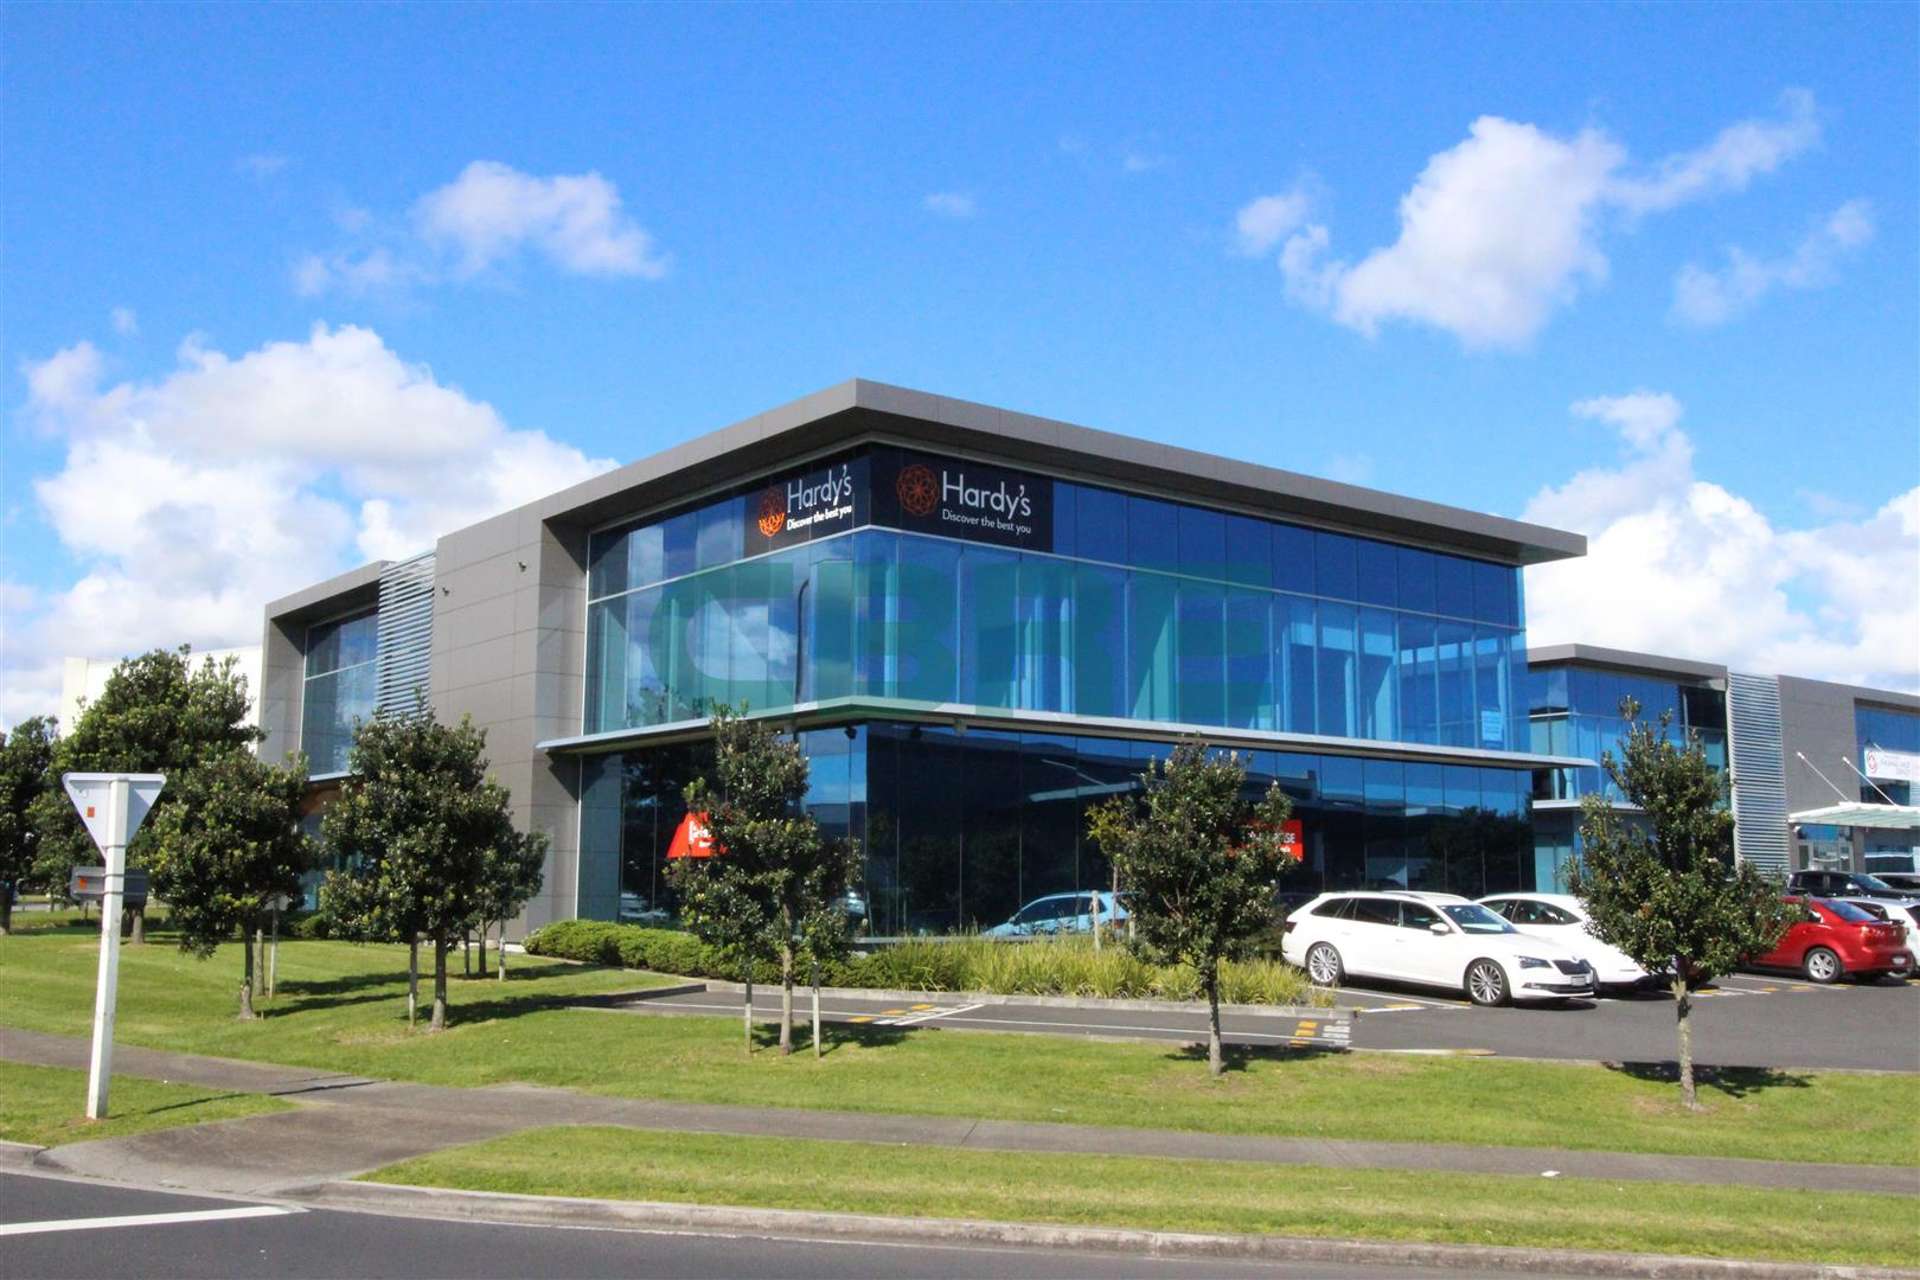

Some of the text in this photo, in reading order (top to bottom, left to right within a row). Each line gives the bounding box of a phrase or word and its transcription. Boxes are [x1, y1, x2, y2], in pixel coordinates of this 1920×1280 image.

[787, 463, 852, 513] Hardy's
[942, 470, 1032, 520] Hardy's
[786, 504, 852, 530] Discover the best you
[942, 508, 1032, 536] Discover the best you
